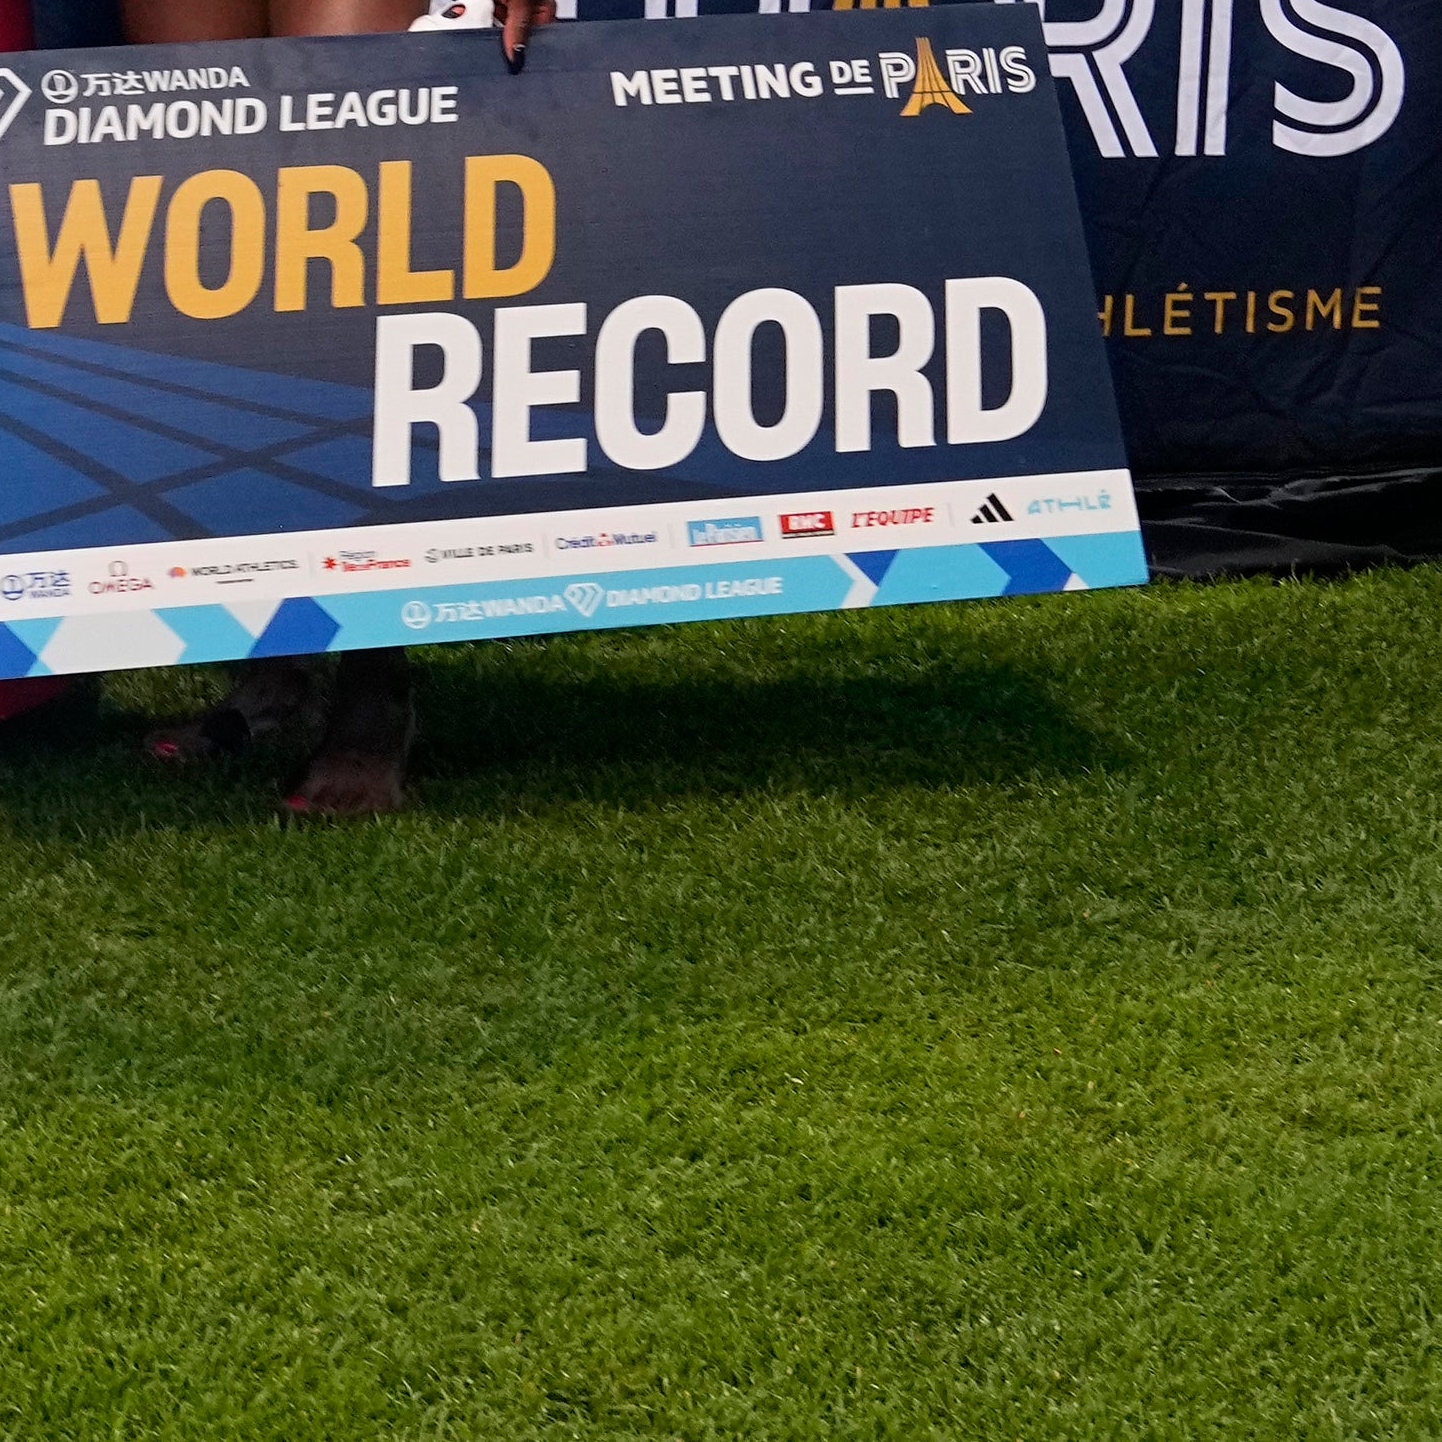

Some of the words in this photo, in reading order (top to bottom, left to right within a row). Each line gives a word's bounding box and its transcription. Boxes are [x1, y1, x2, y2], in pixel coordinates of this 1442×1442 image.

[610, 61, 823, 107] MEETING
[829, 59, 874, 90] DE
[878, 37, 1036, 116] PARIS
[44, 97, 267, 146] DIAMOND
[279, 86, 458, 132] LEAGUE
[9, 153, 556, 329] WORLD
[370, 275, 1049, 488] RECORD
[88, 577, 155, 594] OMEGA
[606, 583, 702, 608] DIAMOND
[705, 576, 784, 600] LEAGUE
